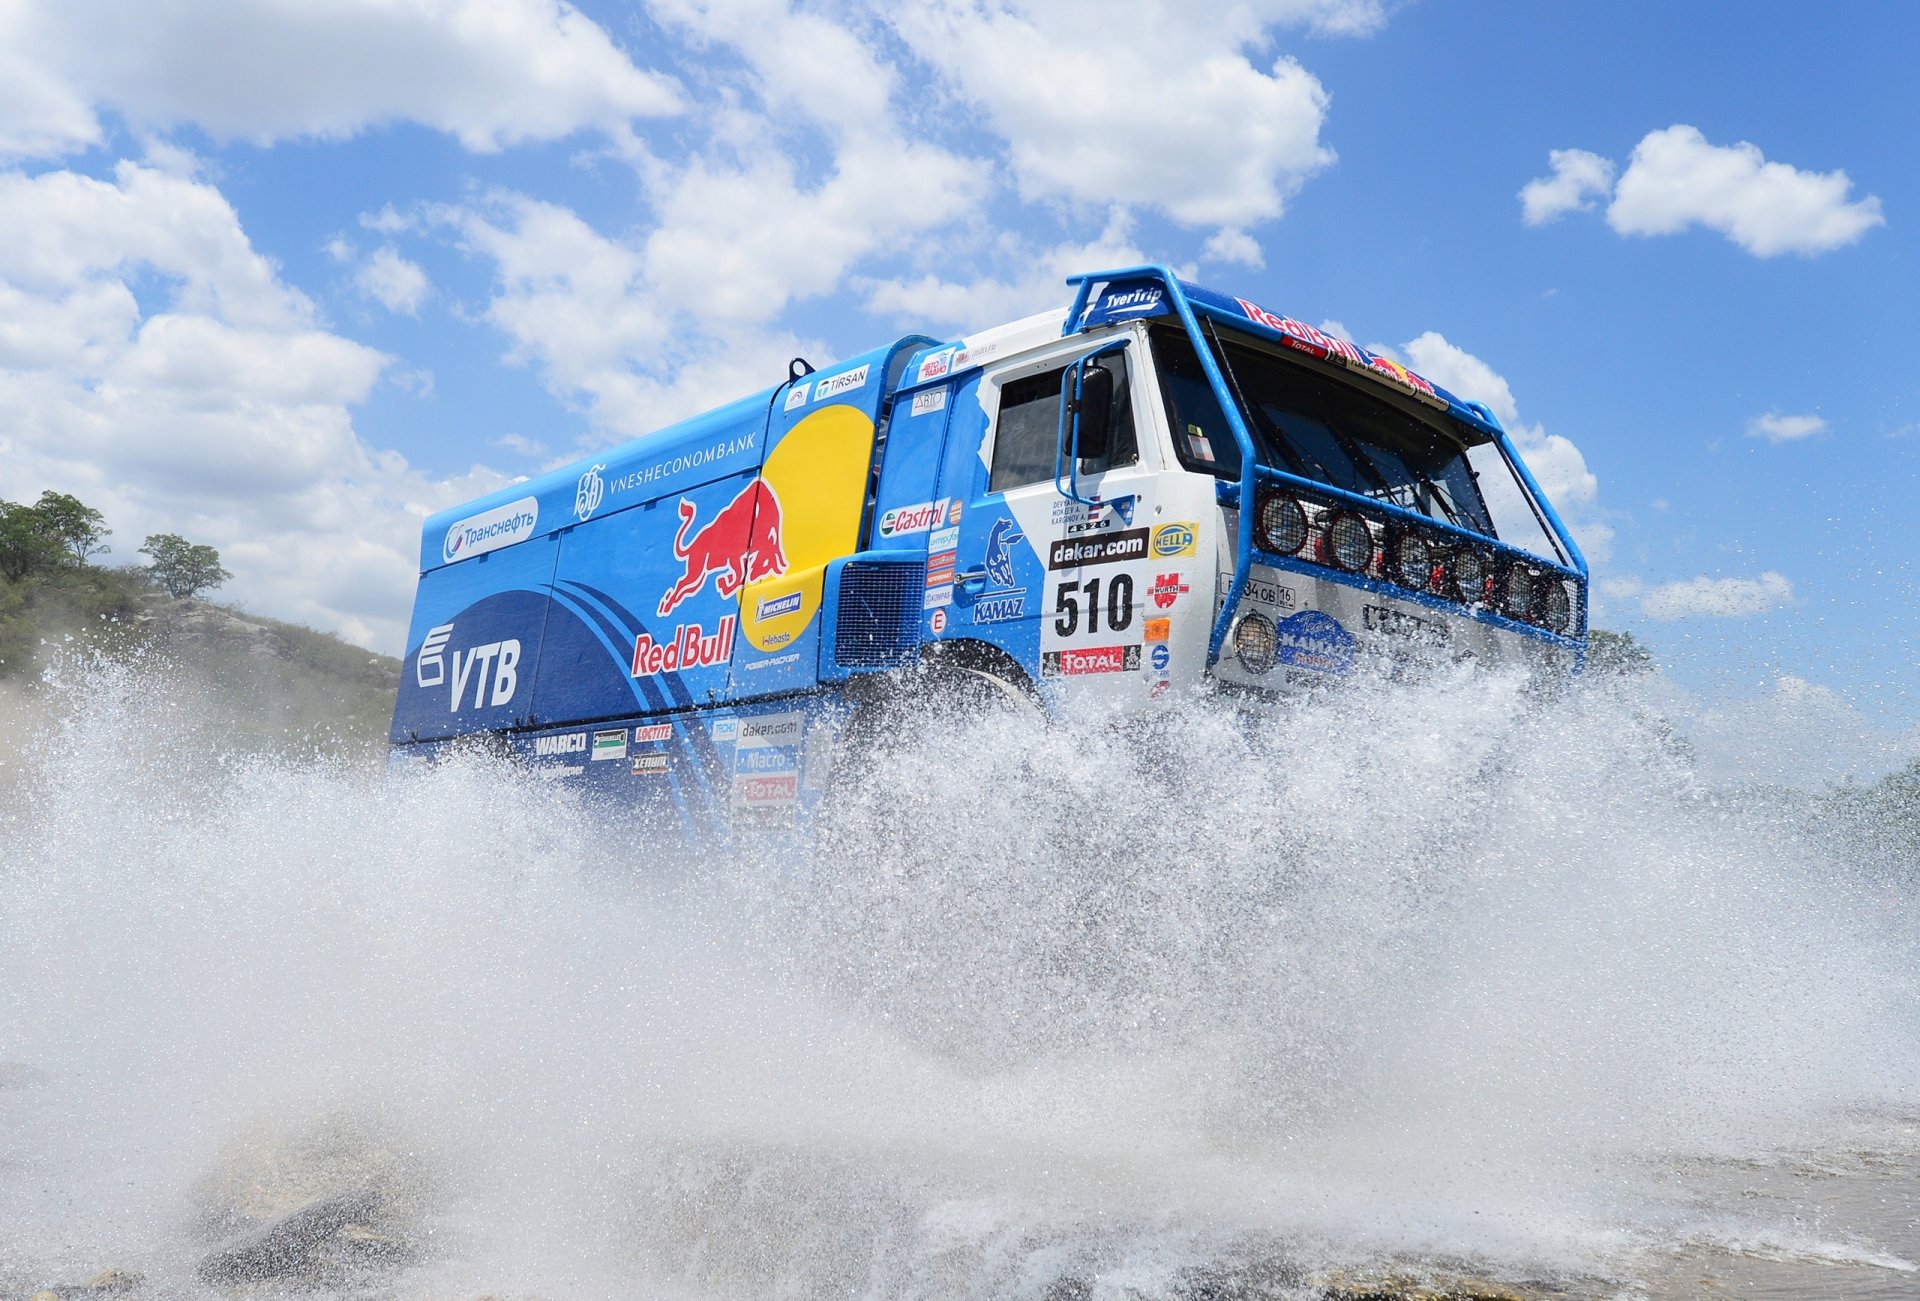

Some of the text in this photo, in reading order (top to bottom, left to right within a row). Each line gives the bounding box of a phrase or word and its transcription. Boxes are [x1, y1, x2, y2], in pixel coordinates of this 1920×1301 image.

[1105, 287, 1163, 309] TverTrip
[1234, 296, 1363, 363] Red Bull
[1290, 340, 1316, 355] TOTAL
[610, 432, 756, 495] VNESHECONOMBANK
[894, 503, 945, 532] Castrol
[464, 513, 534, 548] Транснефть
[1155, 533, 1193, 548] HELLA
[1053, 538, 1144, 564] dakar.com
[763, 595, 800, 615] MICHELIN
[973, 597, 1026, 625] KAMAZ
[1055, 573, 1134, 638] 510
[934, 613, 943, 630] E
[632, 614, 737, 678] Red Bull
[1063, 652, 1122, 671] TOTAL
[450, 639, 521, 713] VTB
[637, 725, 671, 741] LOCTITE
[742, 721, 797, 738] dakar.com
[535, 732, 587, 756] WABCO
[748, 751, 786, 769] Macro
[747, 783, 794, 798] TOTAL
